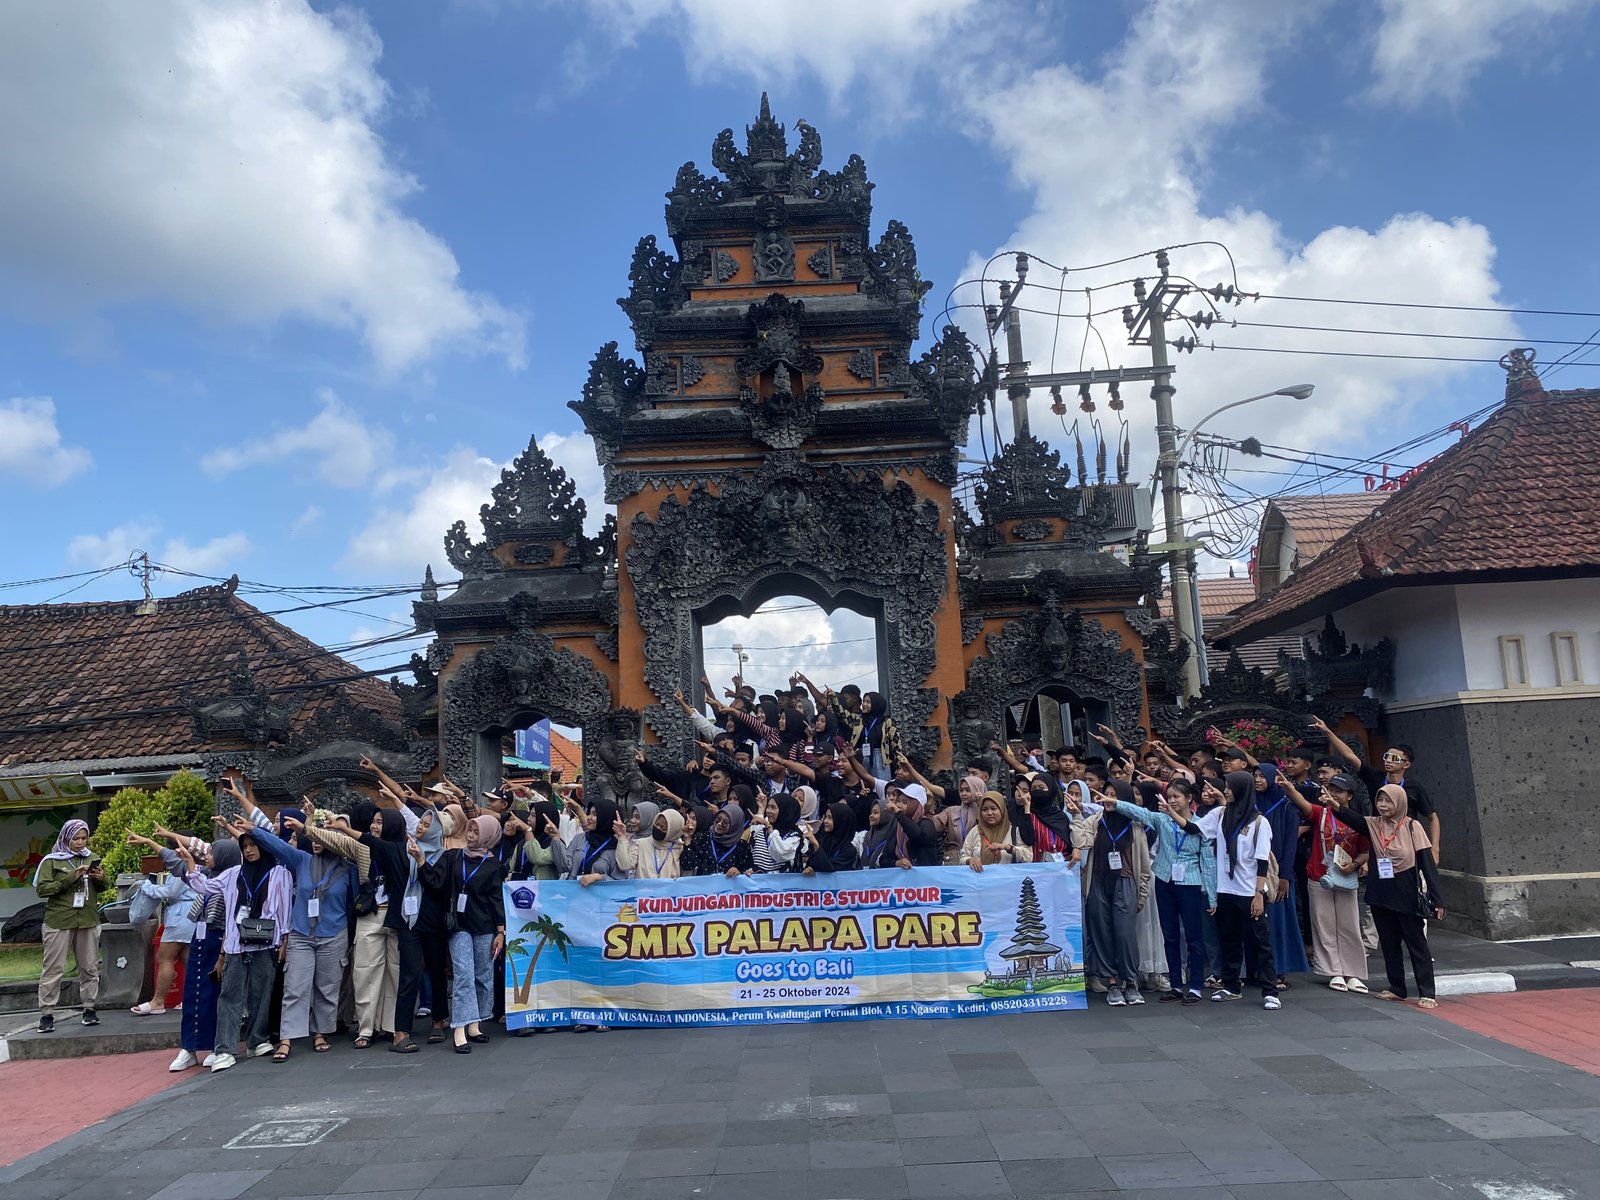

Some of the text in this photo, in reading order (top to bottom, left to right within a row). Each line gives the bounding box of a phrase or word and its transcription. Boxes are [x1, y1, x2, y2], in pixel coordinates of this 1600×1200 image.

[822, 892, 836, 906] &
[838, 889, 891, 905] STUDY
[894, 887, 940, 902] TOUR
[605, 912, 982, 959] SMK PALAPA PARE
[736, 957, 853, 981] Goes to Bali
[740, 989, 753, 999] 21
[763, 988, 776, 998] 25
[778, 987, 822, 997] Oktober
[825, 986, 850, 996] 2024
[525, 1013, 549, 1023] BPW.
[552, 1012, 567, 1022] PT.
[570, 1011, 595, 1021] MEGA
[597, 1011, 616, 1021] AYU
[617, 1012, 672, 1023] NUSANTARA
[675, 1012, 729, 1023] INDONESIA,
[732, 1010, 763, 1021] Perum
[766, 1008, 823, 1020] Kwadungan
[861, 1005, 883, 1015] Blok
[885, 1006, 892, 1015] A
[894, 1005, 908, 1015] 15
[910, 1004, 949, 1016] Ngasem
[957, 1003, 989, 1014] Kediri,
[991, 996, 1067, 1010] 085203315228
